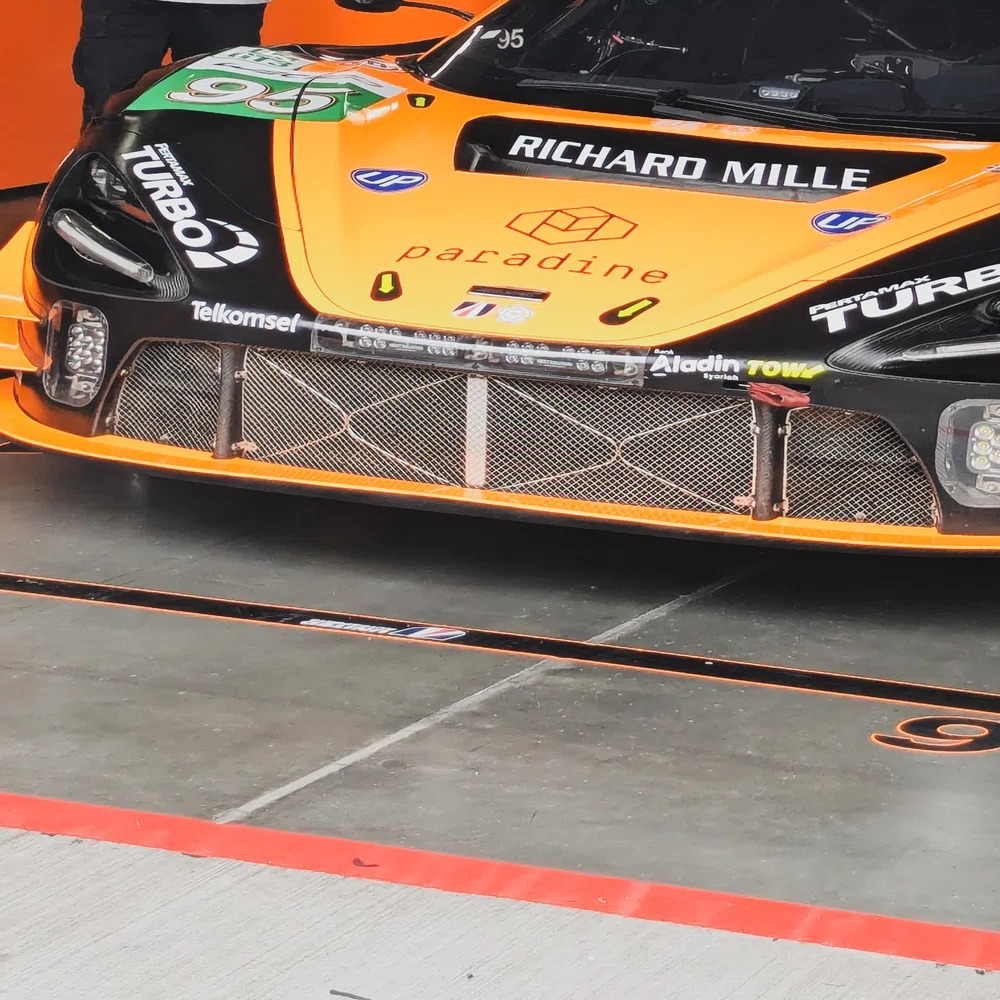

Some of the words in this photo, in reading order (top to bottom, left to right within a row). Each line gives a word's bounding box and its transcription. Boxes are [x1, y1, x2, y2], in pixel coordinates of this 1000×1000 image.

[497, 28, 524, 49] 95
[165, 76, 360, 115] 95
[154, 142, 195, 187] PERTAMAX
[508, 134, 707, 180] RICHARD
[721, 161, 871, 192] MILLE
[121, 144, 214, 249] TURBO
[396, 245, 669, 284] paradine
[808, 275, 932, 315] PERTAMAX
[190, 300, 300, 333] Telkomsel
[650, 354, 740, 374] Aladin
[746, 359, 808, 378] TOW
